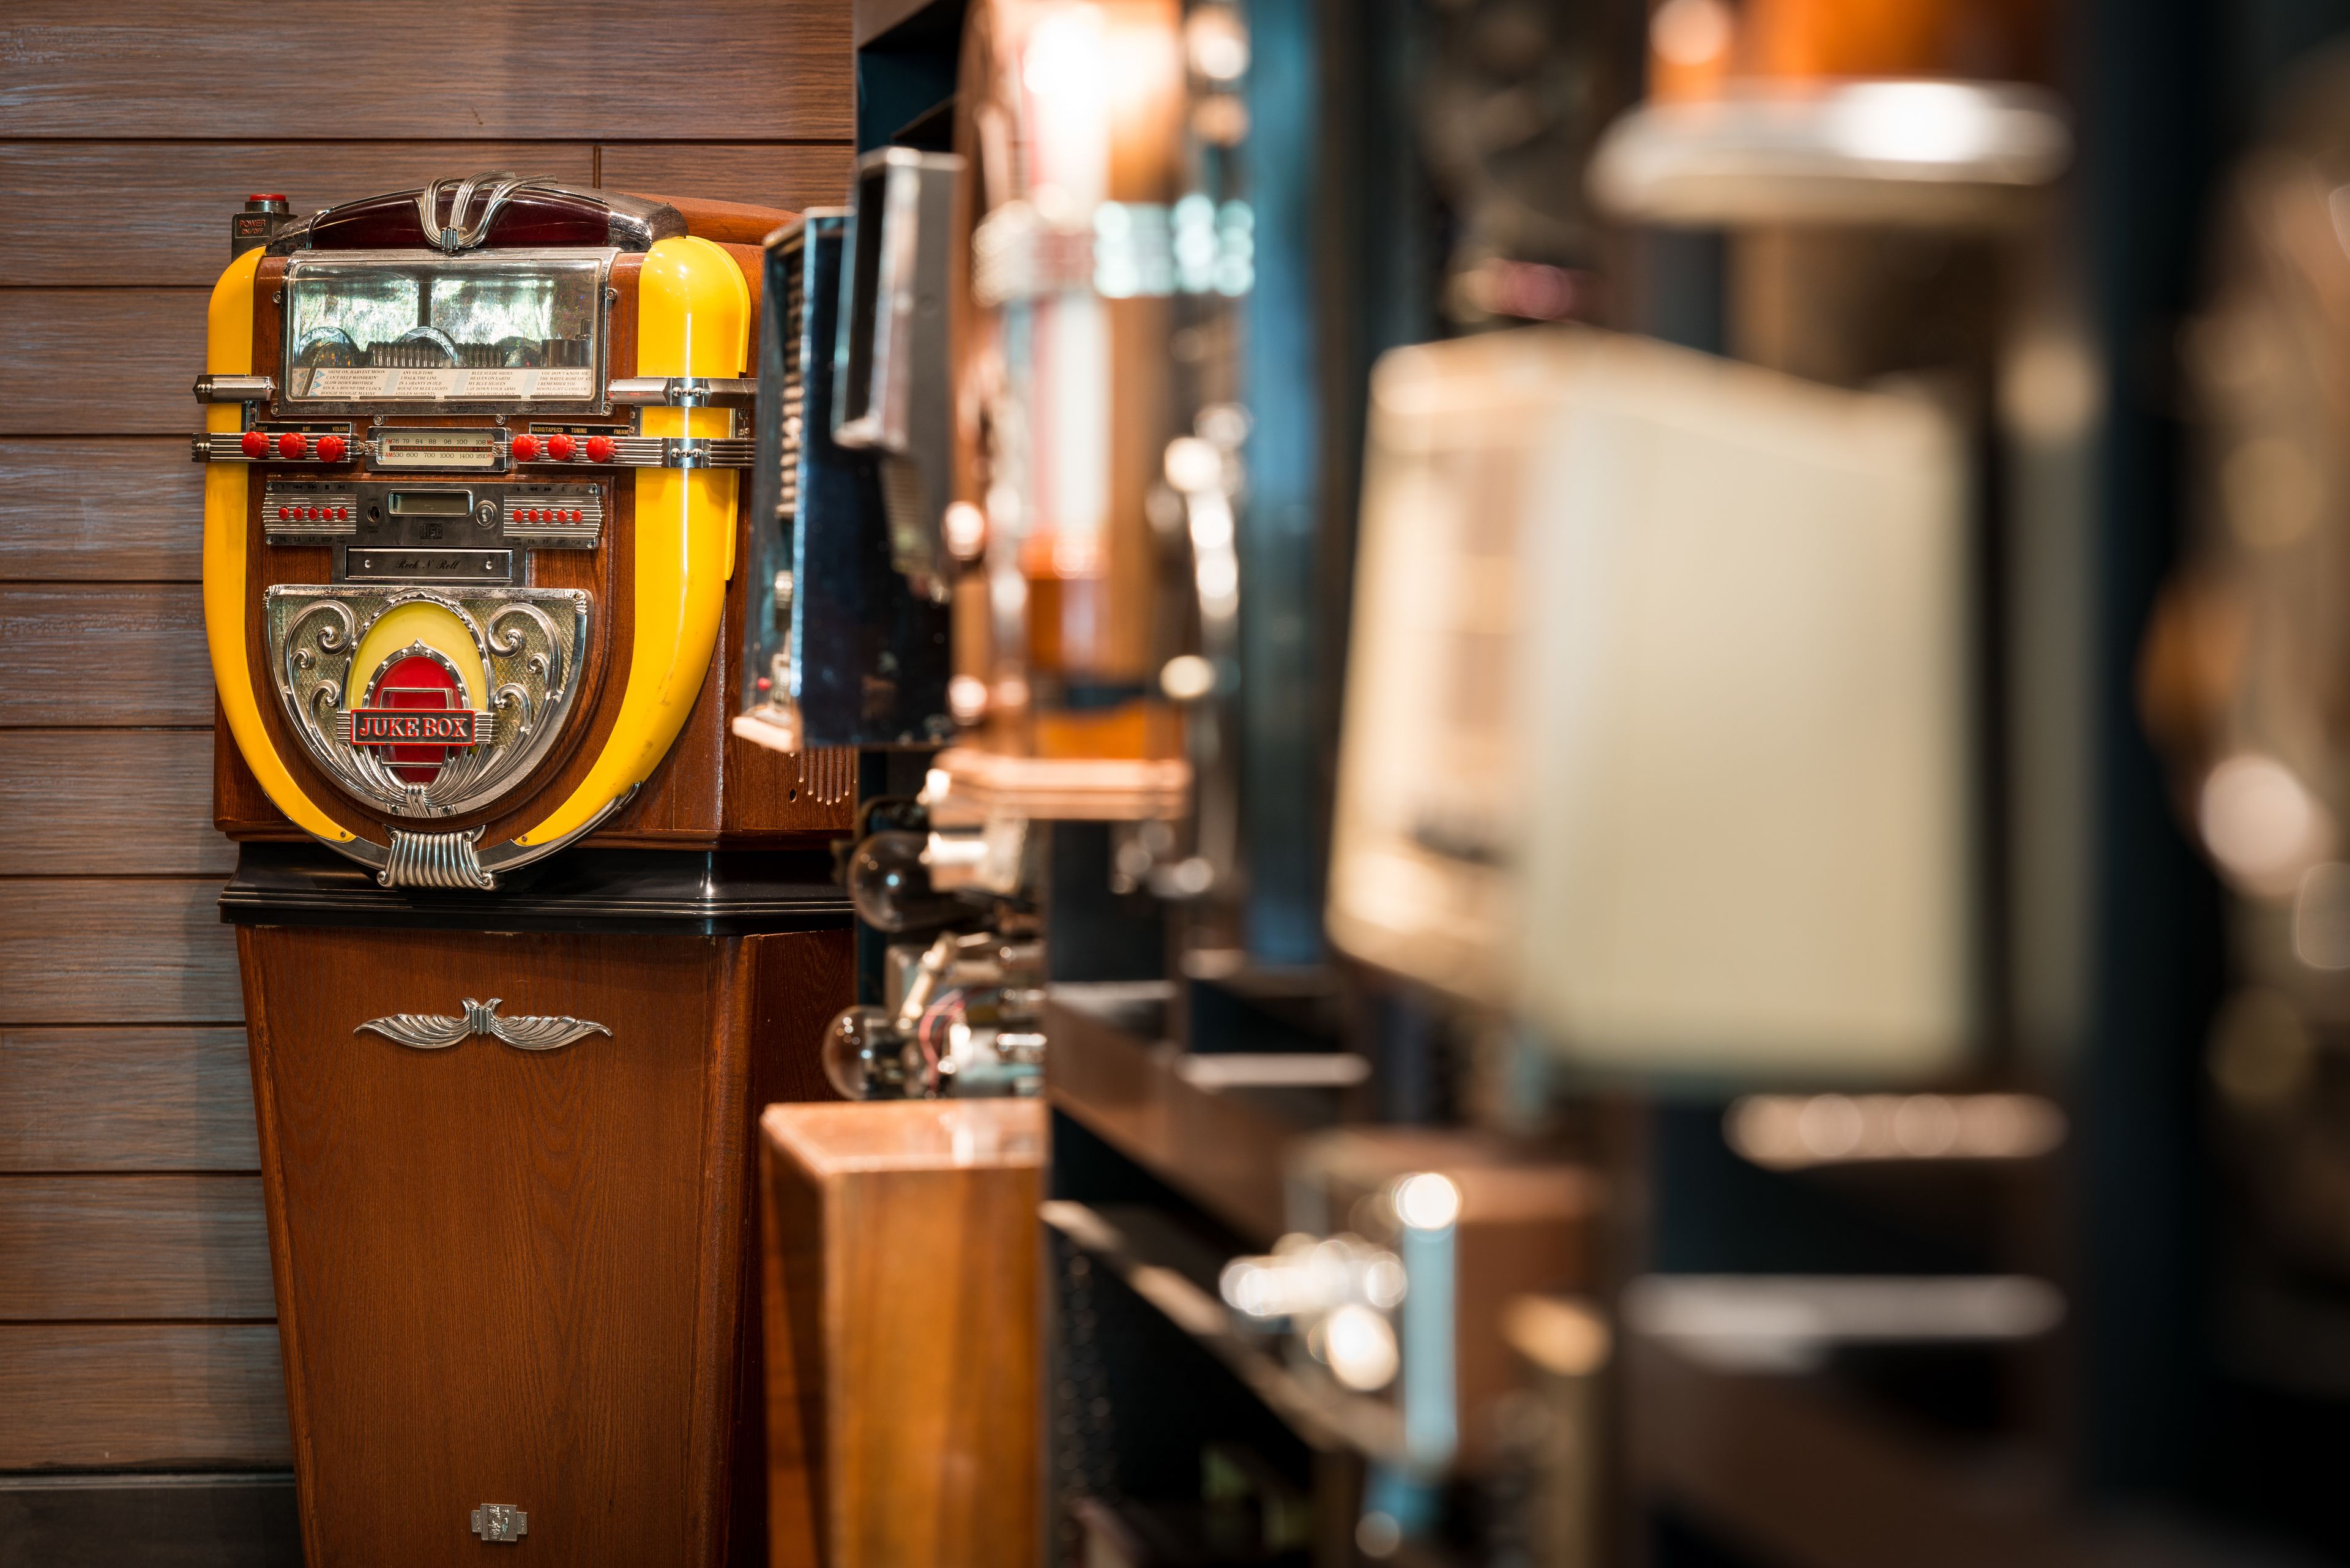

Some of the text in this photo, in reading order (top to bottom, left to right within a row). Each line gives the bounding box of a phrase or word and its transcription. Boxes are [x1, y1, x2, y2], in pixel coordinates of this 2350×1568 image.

[395, 559, 419, 569] Rock
[436, 559, 460, 569] Roll
[359, 718, 468, 737] JUKE BOX
